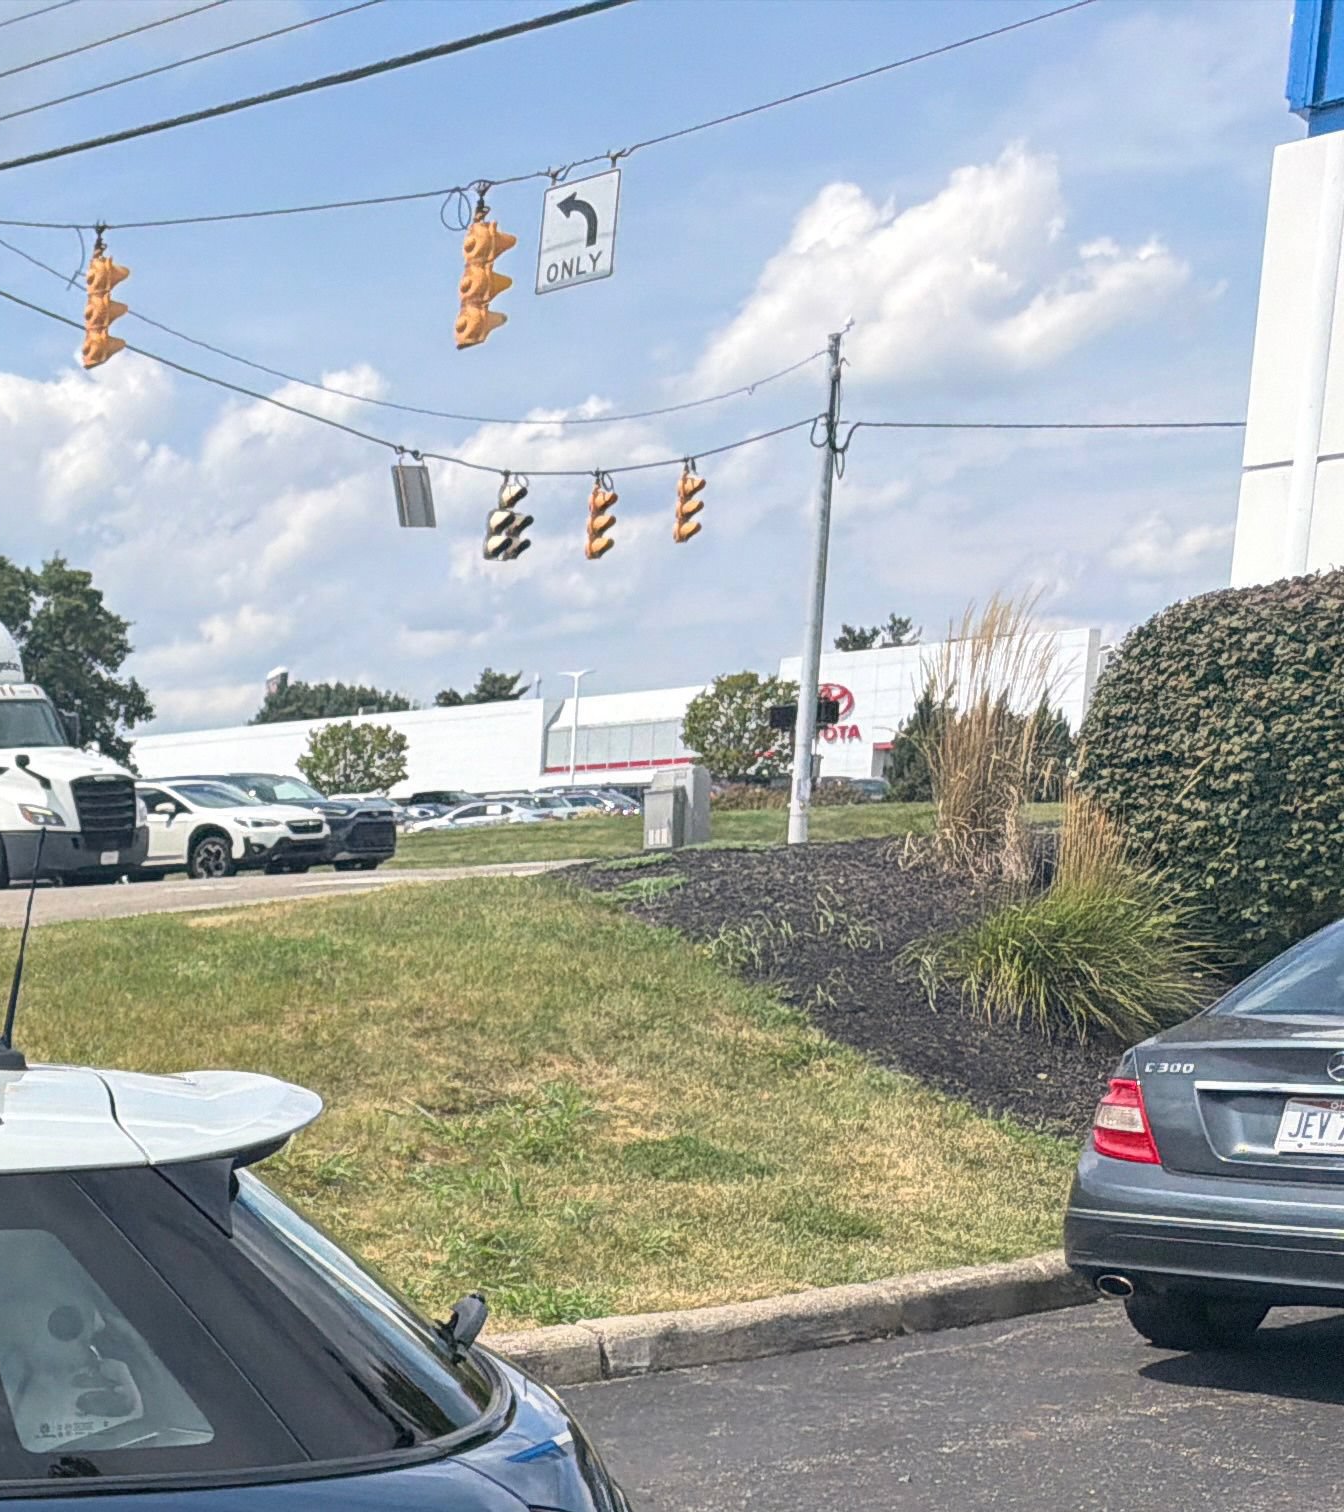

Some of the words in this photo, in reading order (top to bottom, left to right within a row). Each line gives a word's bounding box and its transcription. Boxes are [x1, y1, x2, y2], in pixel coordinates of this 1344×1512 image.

[547, 251, 603, 283] ONLY
[821, 724, 862, 742] OTA
[1287, 1111, 1332, 1140] JEV
